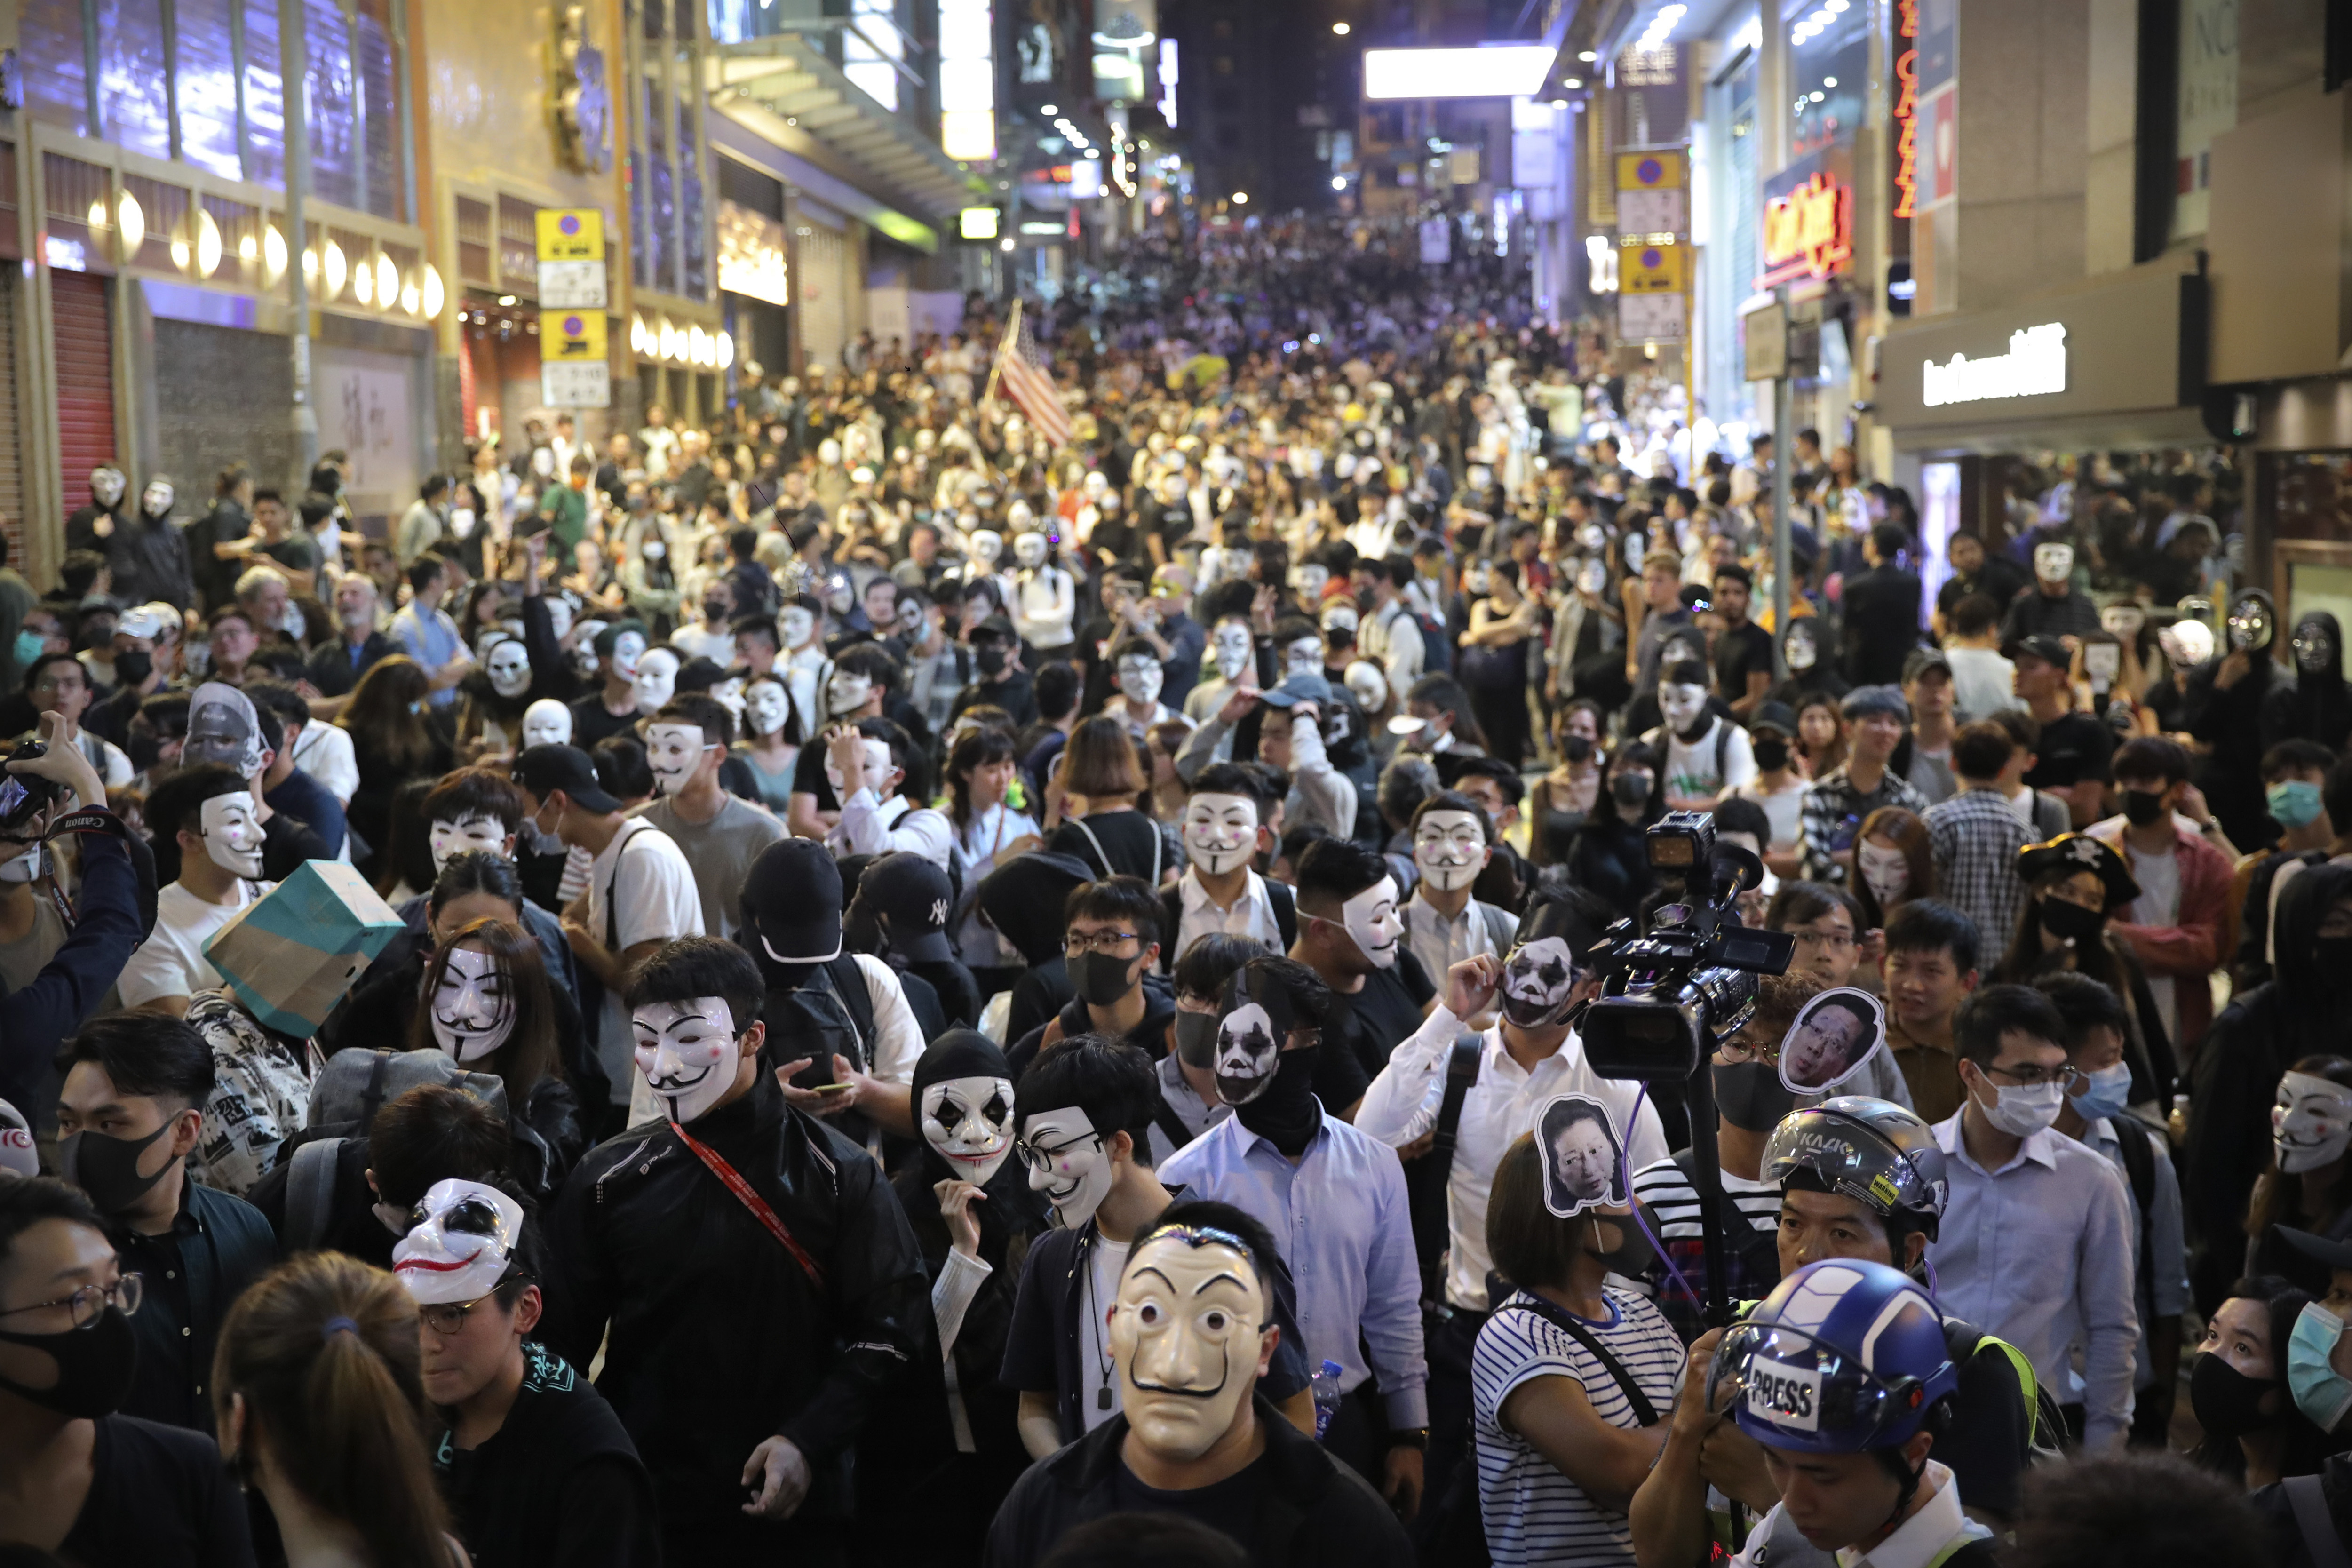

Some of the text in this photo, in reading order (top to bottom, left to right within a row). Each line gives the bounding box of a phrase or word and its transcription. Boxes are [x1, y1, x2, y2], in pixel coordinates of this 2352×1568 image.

[65, 817, 105, 828] Canon
[929, 898, 948, 925] NY
[1874, 1179, 1896, 1200] WARNING
[1752, 1369, 1812, 1417] PRESS
